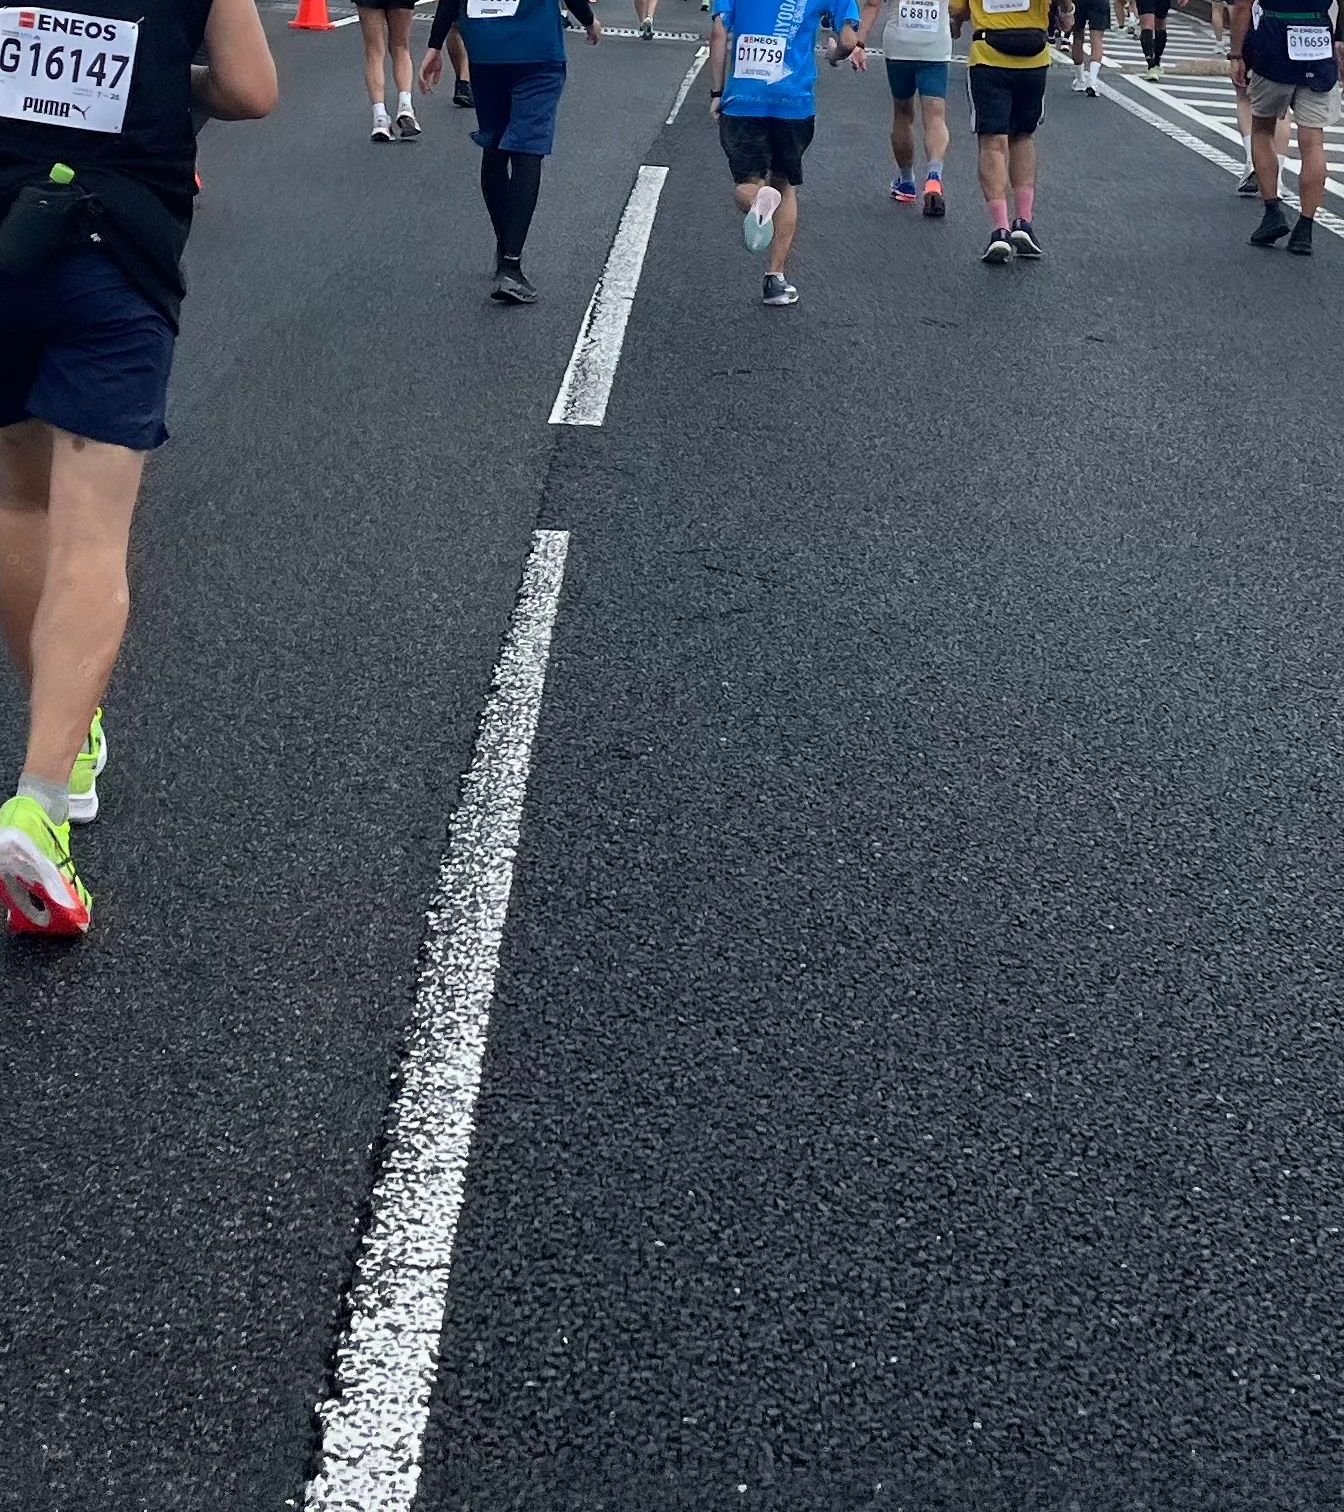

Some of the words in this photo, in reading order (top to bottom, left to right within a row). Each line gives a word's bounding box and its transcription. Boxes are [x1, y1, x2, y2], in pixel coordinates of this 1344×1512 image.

[38, 14, 117, 41] ENEOS
[1289, 36, 1330, 47] G16659
[0, 37, 130, 89] G16147
[738, 47, 783, 64] D11759
[22, 96, 71, 118] PUMA
